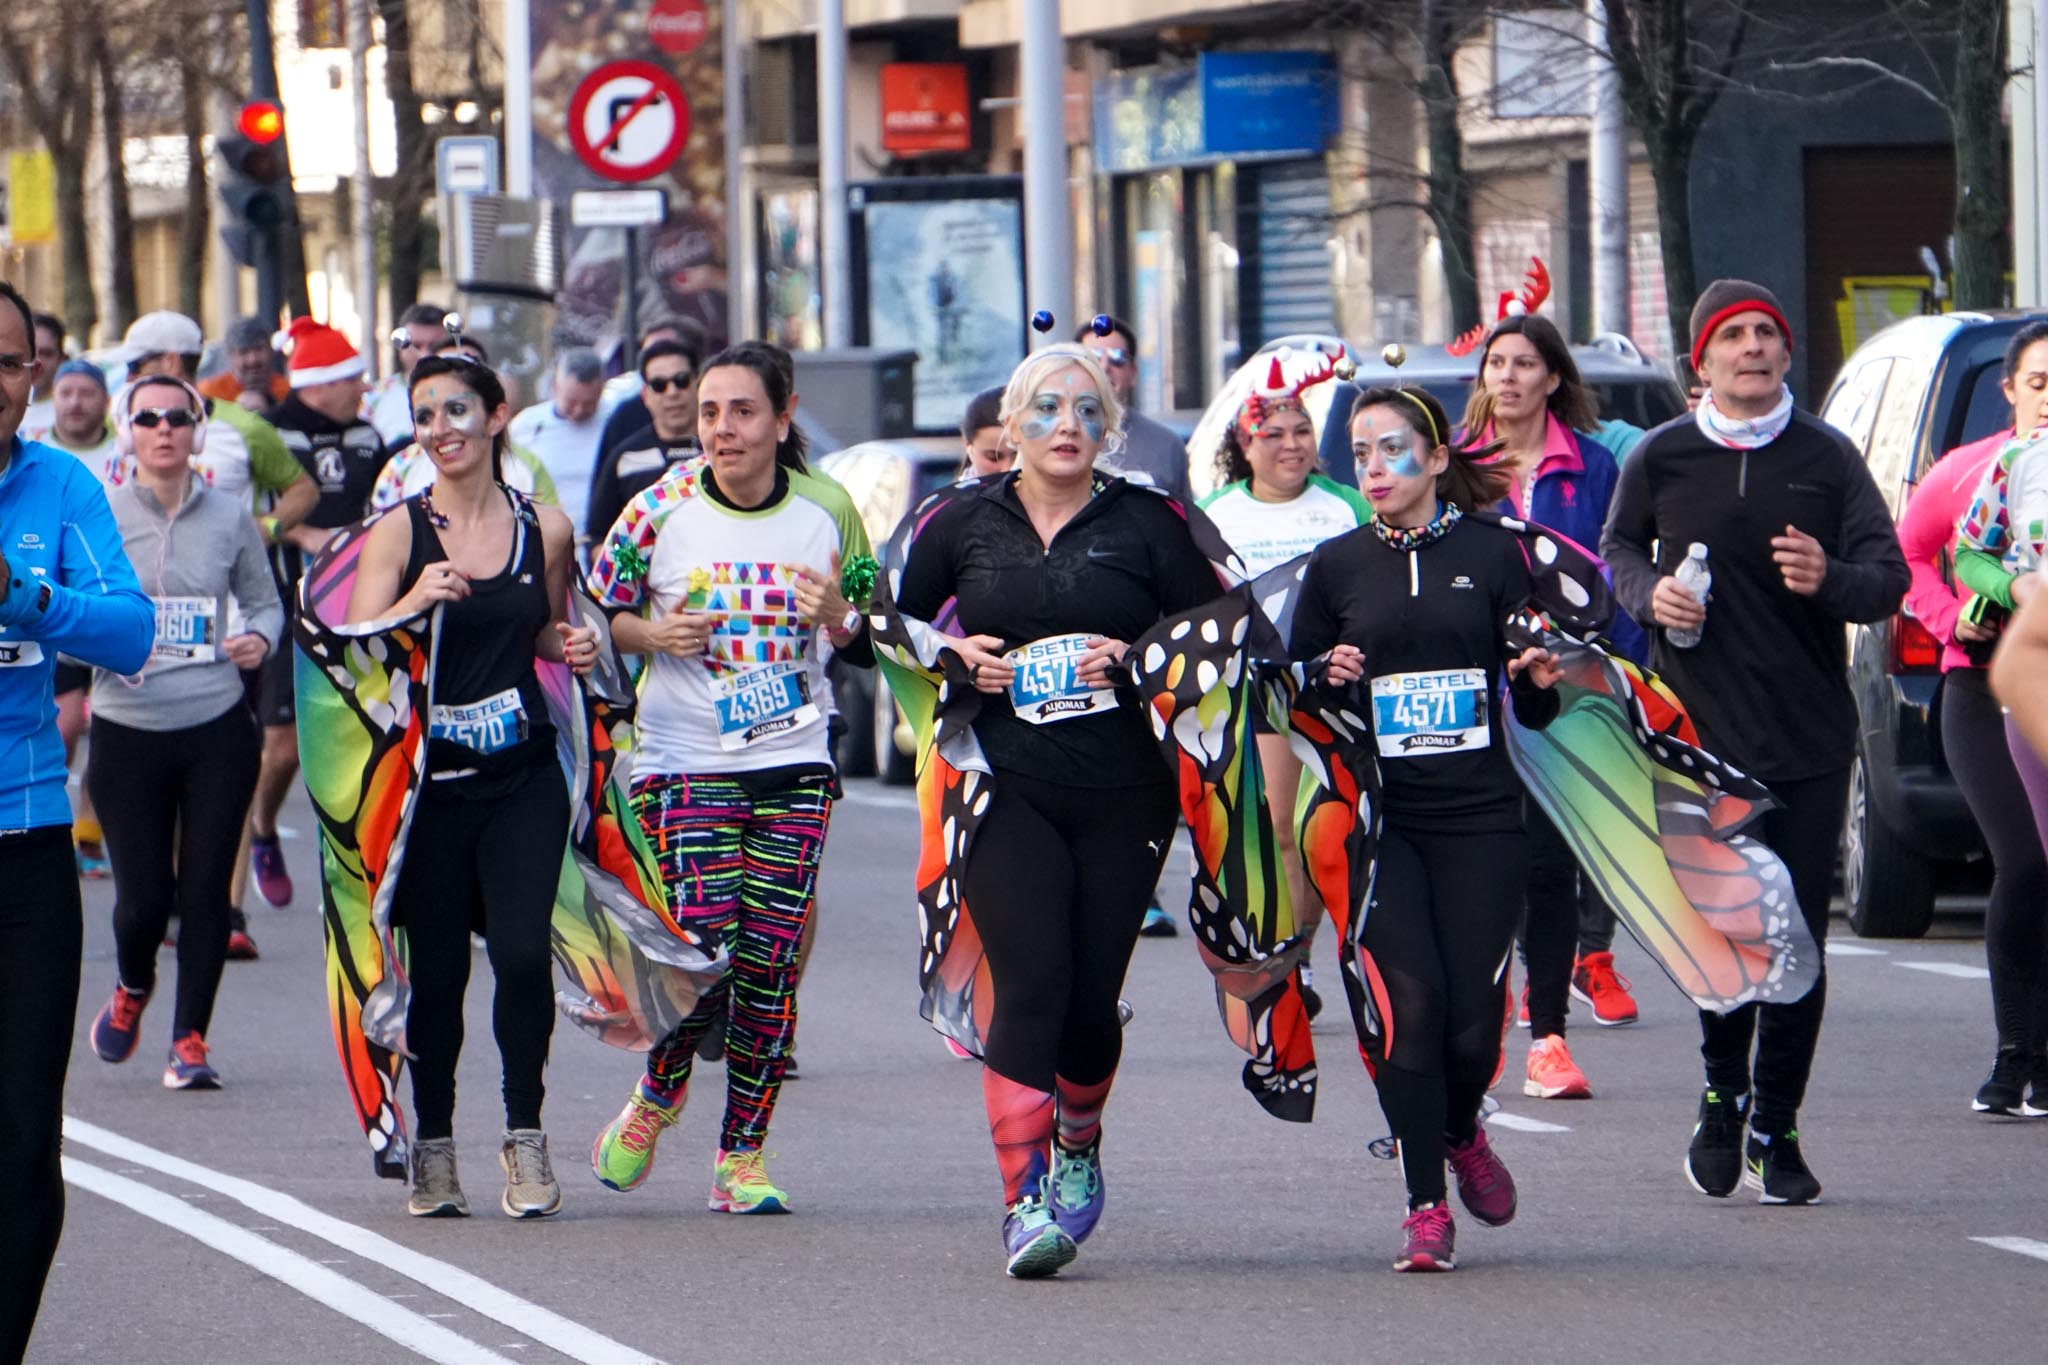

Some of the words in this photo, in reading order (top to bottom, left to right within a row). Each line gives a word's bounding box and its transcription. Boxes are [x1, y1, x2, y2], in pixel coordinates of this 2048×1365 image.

[1029, 637, 1086, 659] SETE
[735, 663, 797, 689] SETEL
[1403, 673, 1475, 690] SETEL
[453, 697, 514, 722] SETEL
[729, 676, 791, 724] 4369
[1045, 701, 1086, 713] ALJOMAR
[1393, 690, 1457, 728] 4571
[750, 720, 791, 737] ALJOMAR
[1411, 736, 1457, 746] ALJOMAR
